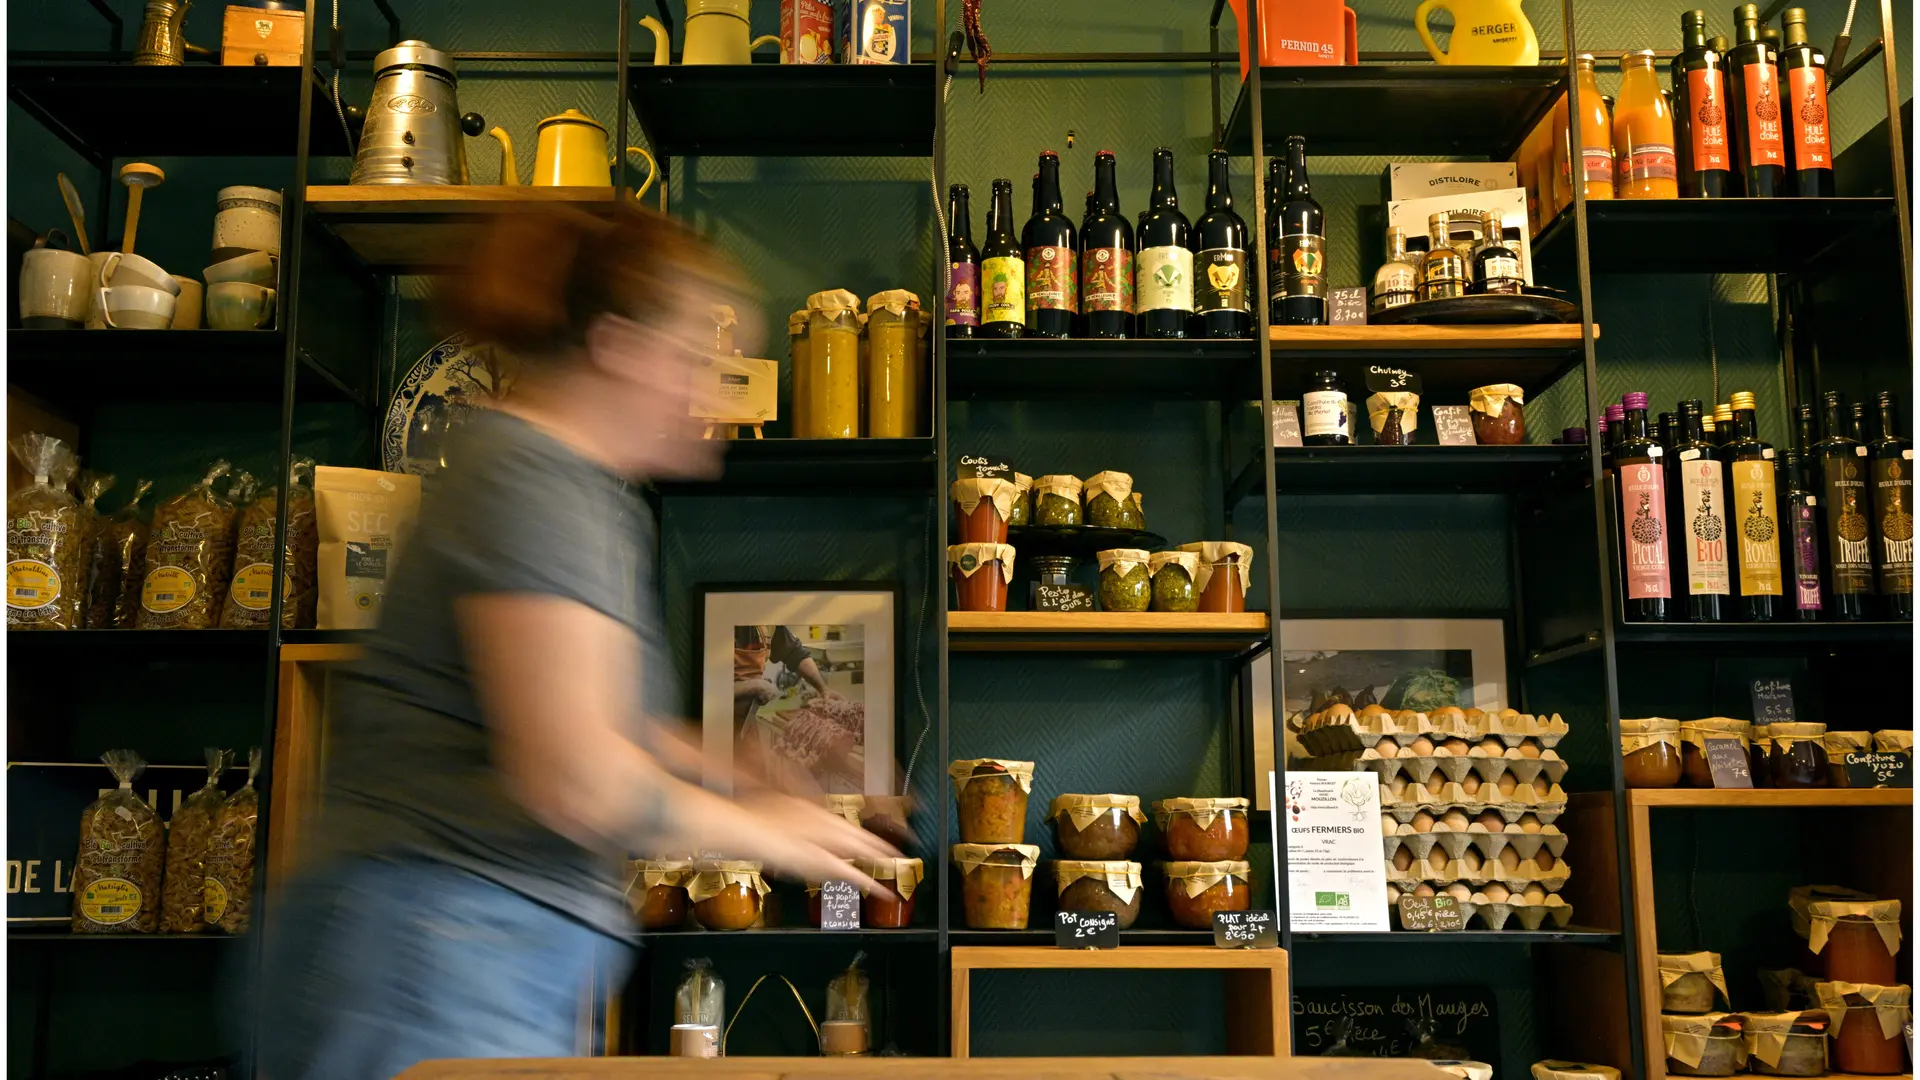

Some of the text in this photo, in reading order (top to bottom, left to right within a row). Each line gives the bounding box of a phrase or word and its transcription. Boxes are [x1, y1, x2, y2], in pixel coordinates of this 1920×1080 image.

[1471, 23, 1516, 36] BERGER
[1281, 39, 1333, 54] PERNOD 45
[1703, 126, 1721, 136] HUILE
[1760, 121, 1777, 132] HUILE
[1805, 125, 1823, 136] HUILE
[1334, 291, 1348, 300] 75
[1387, 289, 1409, 305] GIN
[1370, 365, 1413, 379] Chutney
[1391, 379, 1407, 388] 3€
[1434, 407, 1461, 419] Confit
[961, 455, 988, 465] Coulis
[976, 463, 1009, 472] tomate
[347, 511, 389, 533] SEC
[1632, 540, 1665, 564] PICUAL
[1696, 537, 1723, 562] BIO
[1744, 538, 1777, 563] ROYAL
[1838, 535, 1870, 563] TRUFFE
[1883, 536, 1913, 563] TRUFF
[1038, 586, 1069, 598] Pesto
[1754, 680, 1791, 695] Confiture
[1765, 705, 1781, 715] 5,5
[1707, 740, 1741, 751] Caramel
[1846, 753, 1896, 767] Confiture
[1731, 768, 1748, 778] 7€
[1877, 770, 1895, 781] 5€
[1311, 826, 1352, 834] FERMIERS
[7, 860, 42, 893] DE
[823, 881, 853, 893] Coulis
[1434, 897, 1453, 909] Bio
[835, 910, 857, 919] 5 €
[1058, 912, 1077, 925] Pot
[1217, 914, 1270, 924] PLAT idéal
[1250, 924, 1257, 932] 2
[1427, 920, 1434, 928] 6
[1075, 927, 1096, 938] 2 €
[1292, 992, 1489, 1034] Saucisson des Mauges
